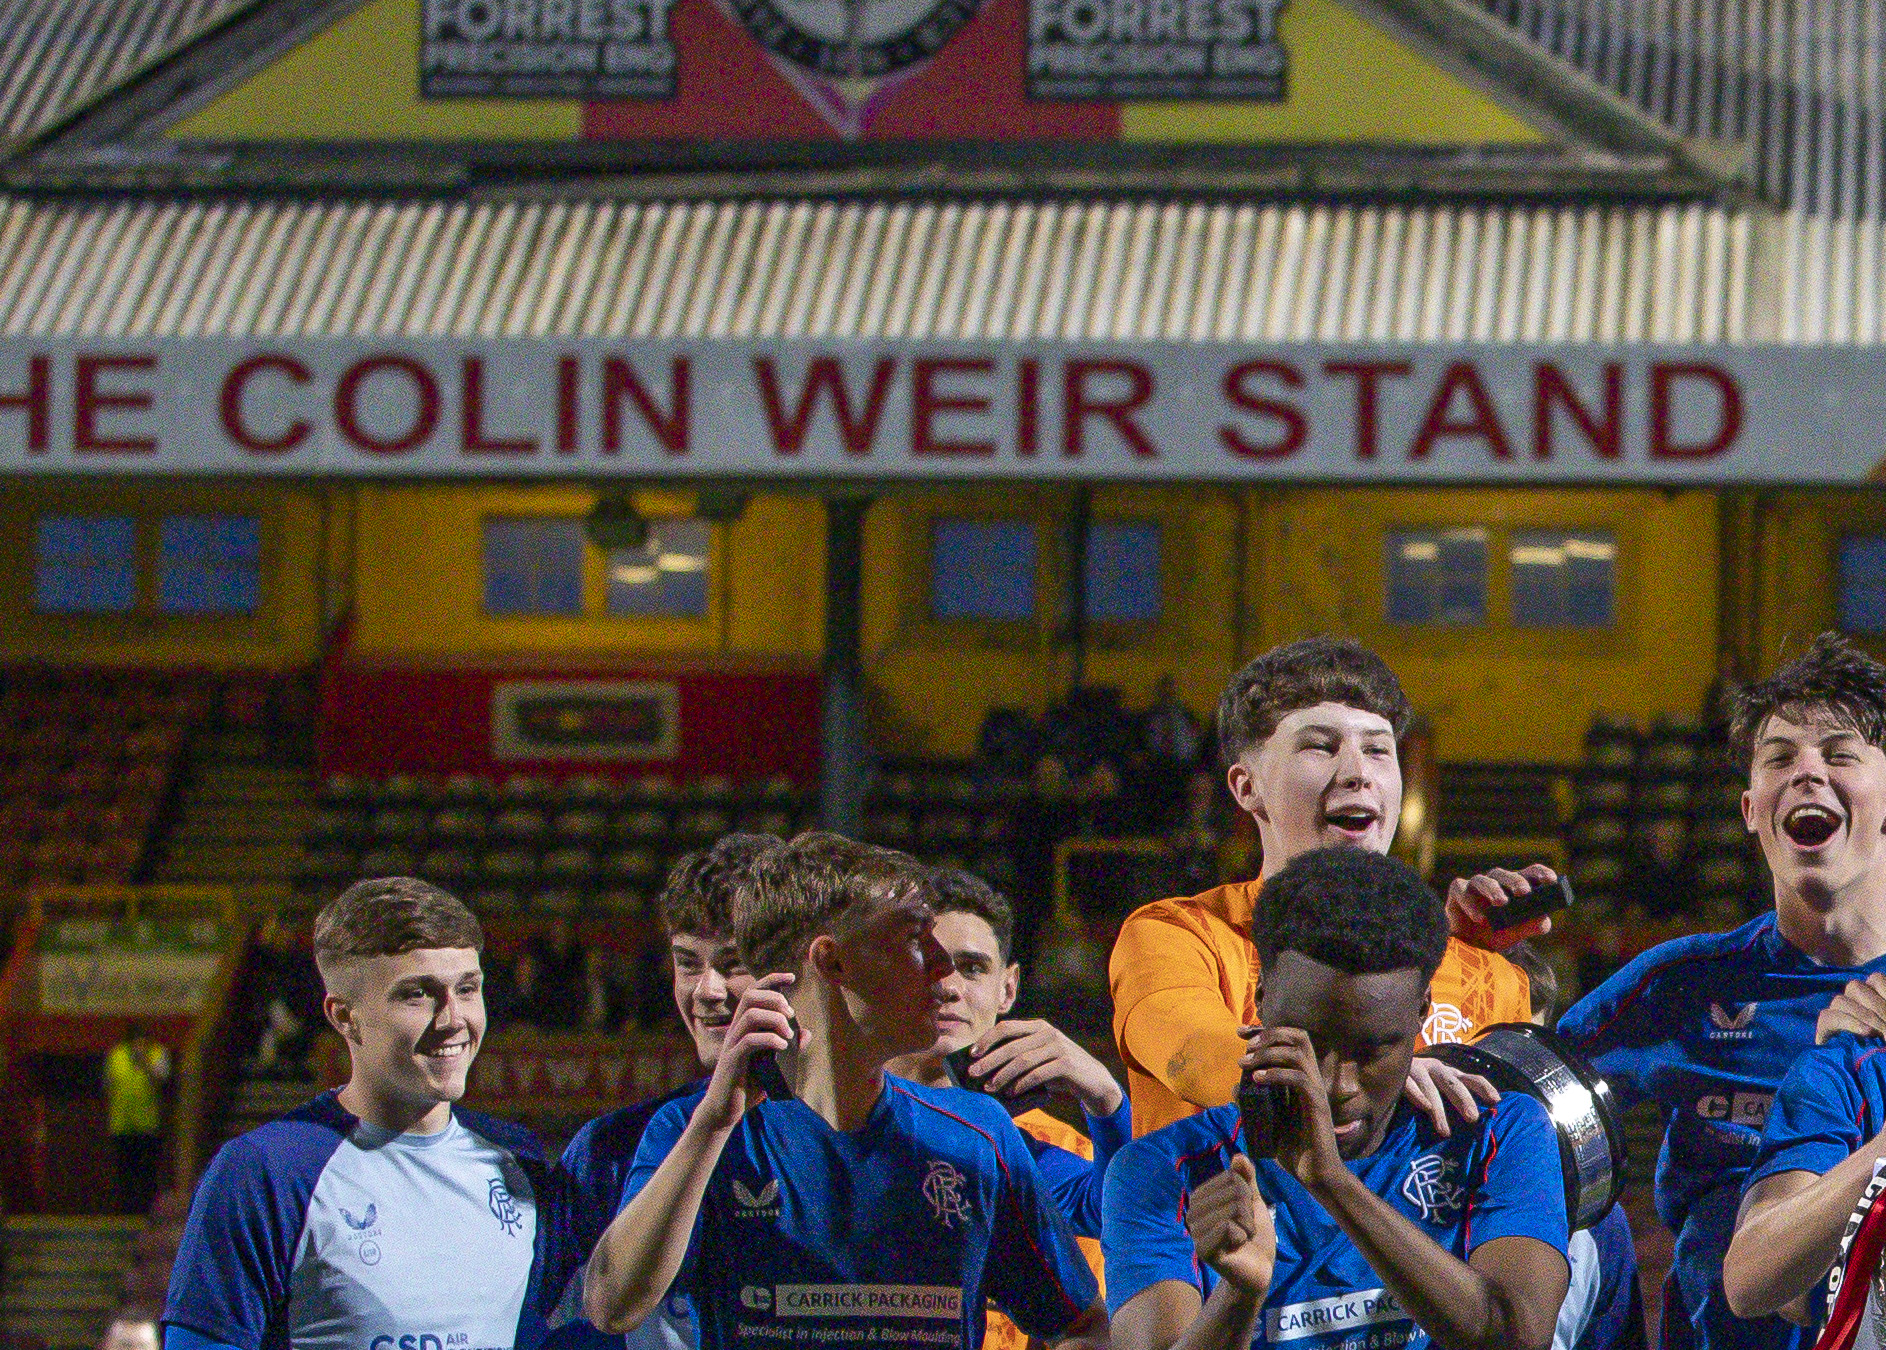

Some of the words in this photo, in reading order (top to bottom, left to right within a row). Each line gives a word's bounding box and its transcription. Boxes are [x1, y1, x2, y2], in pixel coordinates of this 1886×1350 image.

[217, 354, 692, 455] COLIN
[754, 357, 1158, 459] WEIR
[1219, 358, 1744, 462] STAND
[786, 1291, 862, 1308] CARRICK
[868, 1292, 959, 1311] PACKAGING
[1277, 1303, 1359, 1332] CARRICK
[447, 1332, 470, 1345] AIR
